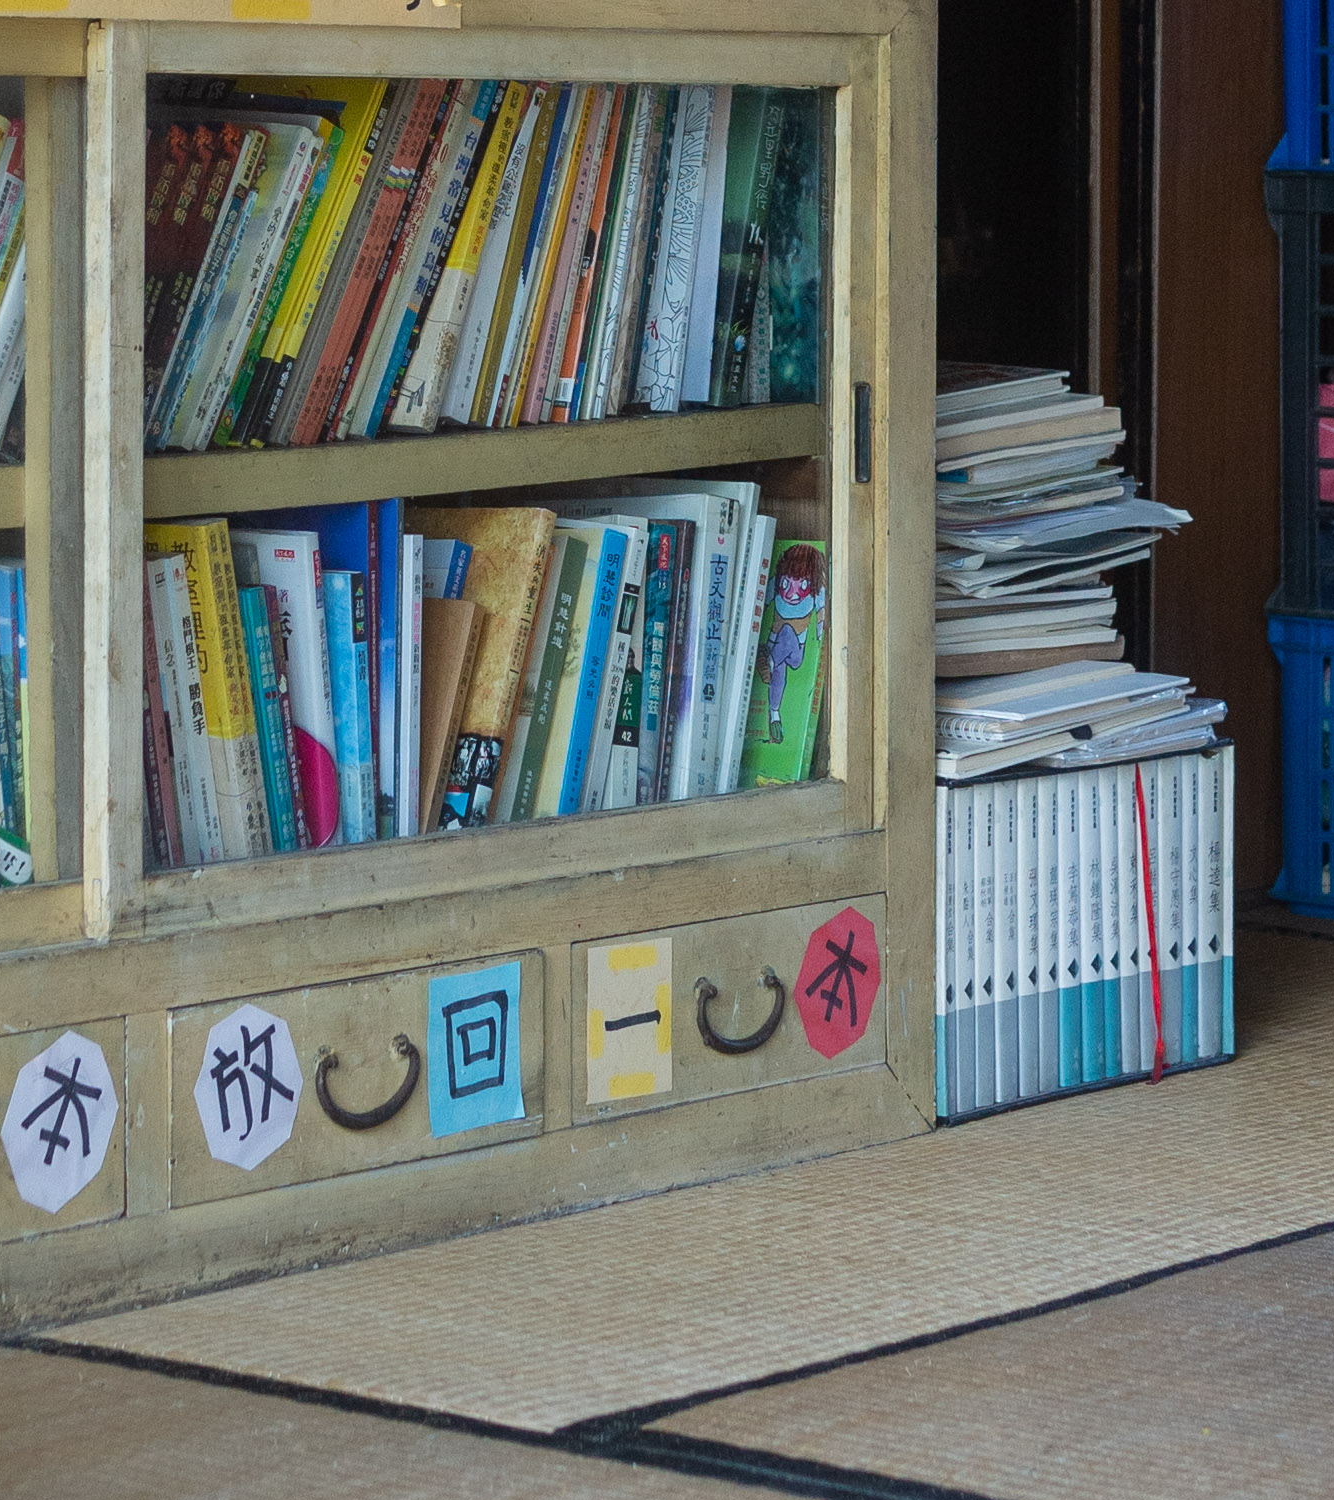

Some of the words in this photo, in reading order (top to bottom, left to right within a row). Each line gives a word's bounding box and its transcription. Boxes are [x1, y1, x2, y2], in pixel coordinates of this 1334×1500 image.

[415, 129, 478, 297] 台灣常見的鳥類
[620, 730, 633, 743] 42
[442, 989, 510, 1099] 回
[603, 1009, 663, 1032] 一
[211, 1022, 295, 1142] 放
